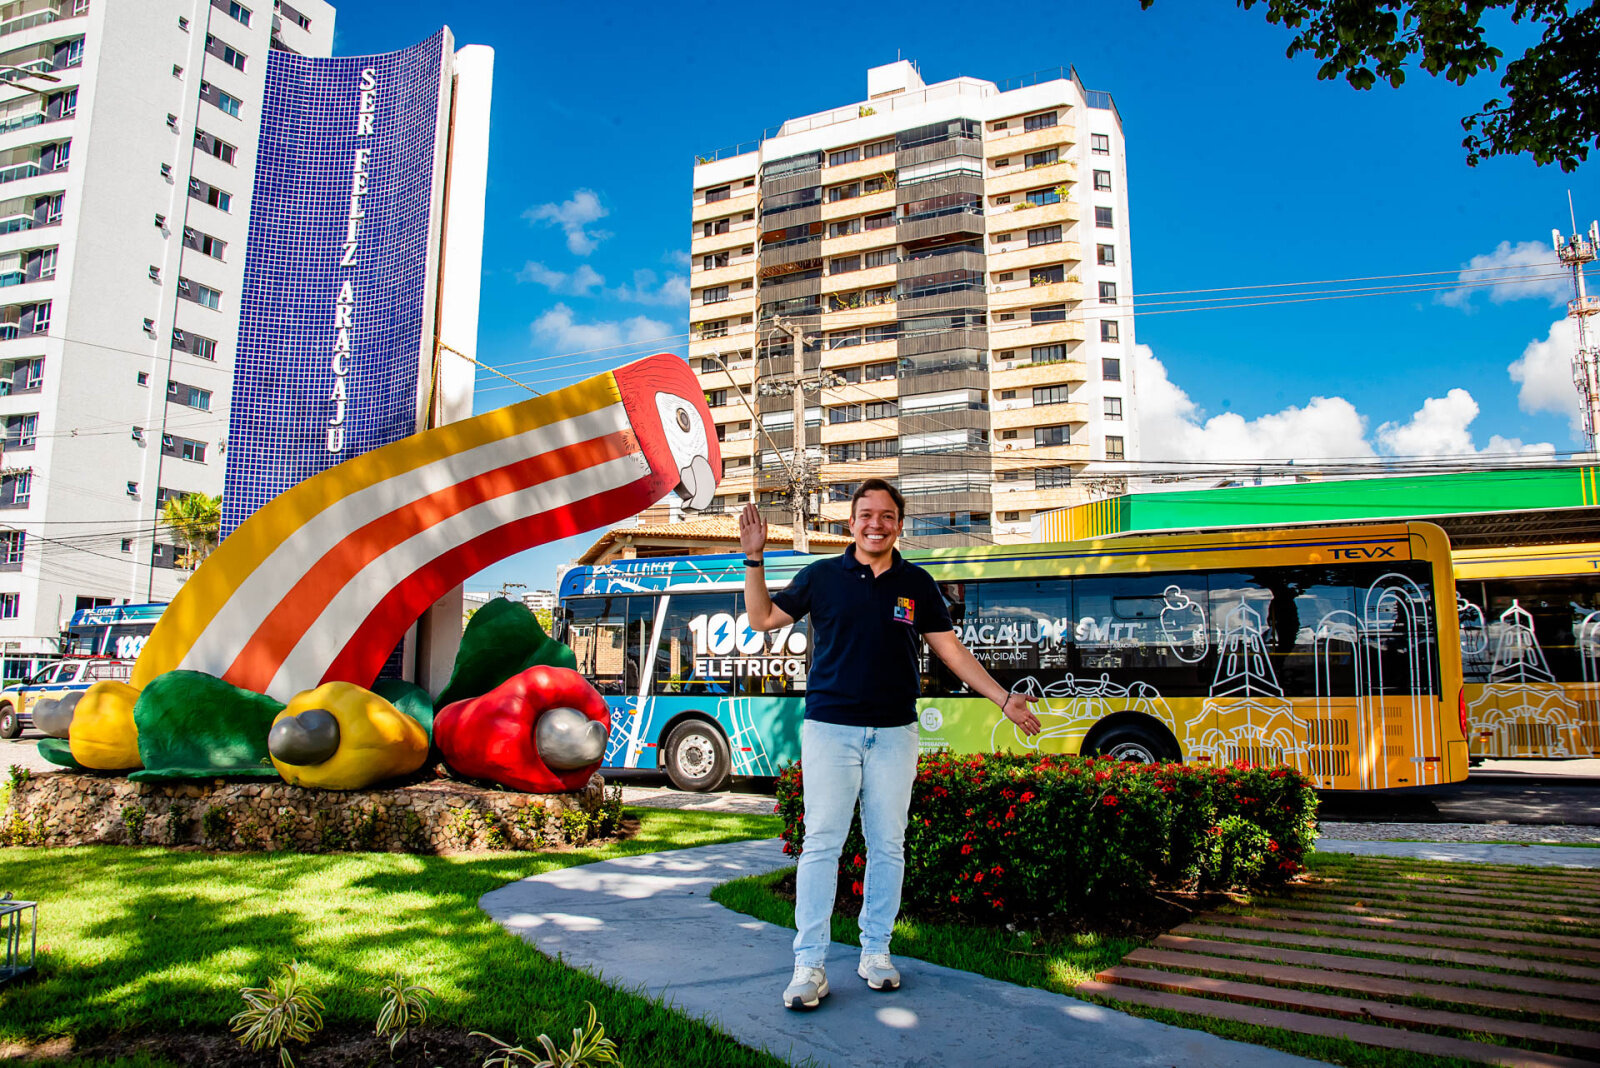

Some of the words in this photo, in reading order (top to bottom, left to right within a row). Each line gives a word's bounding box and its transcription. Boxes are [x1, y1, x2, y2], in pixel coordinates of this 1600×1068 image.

[359, 68, 376, 137] SER
[340, 149, 371, 267] FELIZ
[327, 280, 355, 453] ARACAJU
[1327, 546, 1396, 560] TEVX
[956, 617, 1012, 625] PREFEITURA
[1075, 622, 1138, 642] SMTT
[115, 636, 149, 659] 100
[973, 652, 991, 661] OVA
[993, 651, 1028, 661] CIDADE
[695, 655, 800, 677] ELÉTRICO
